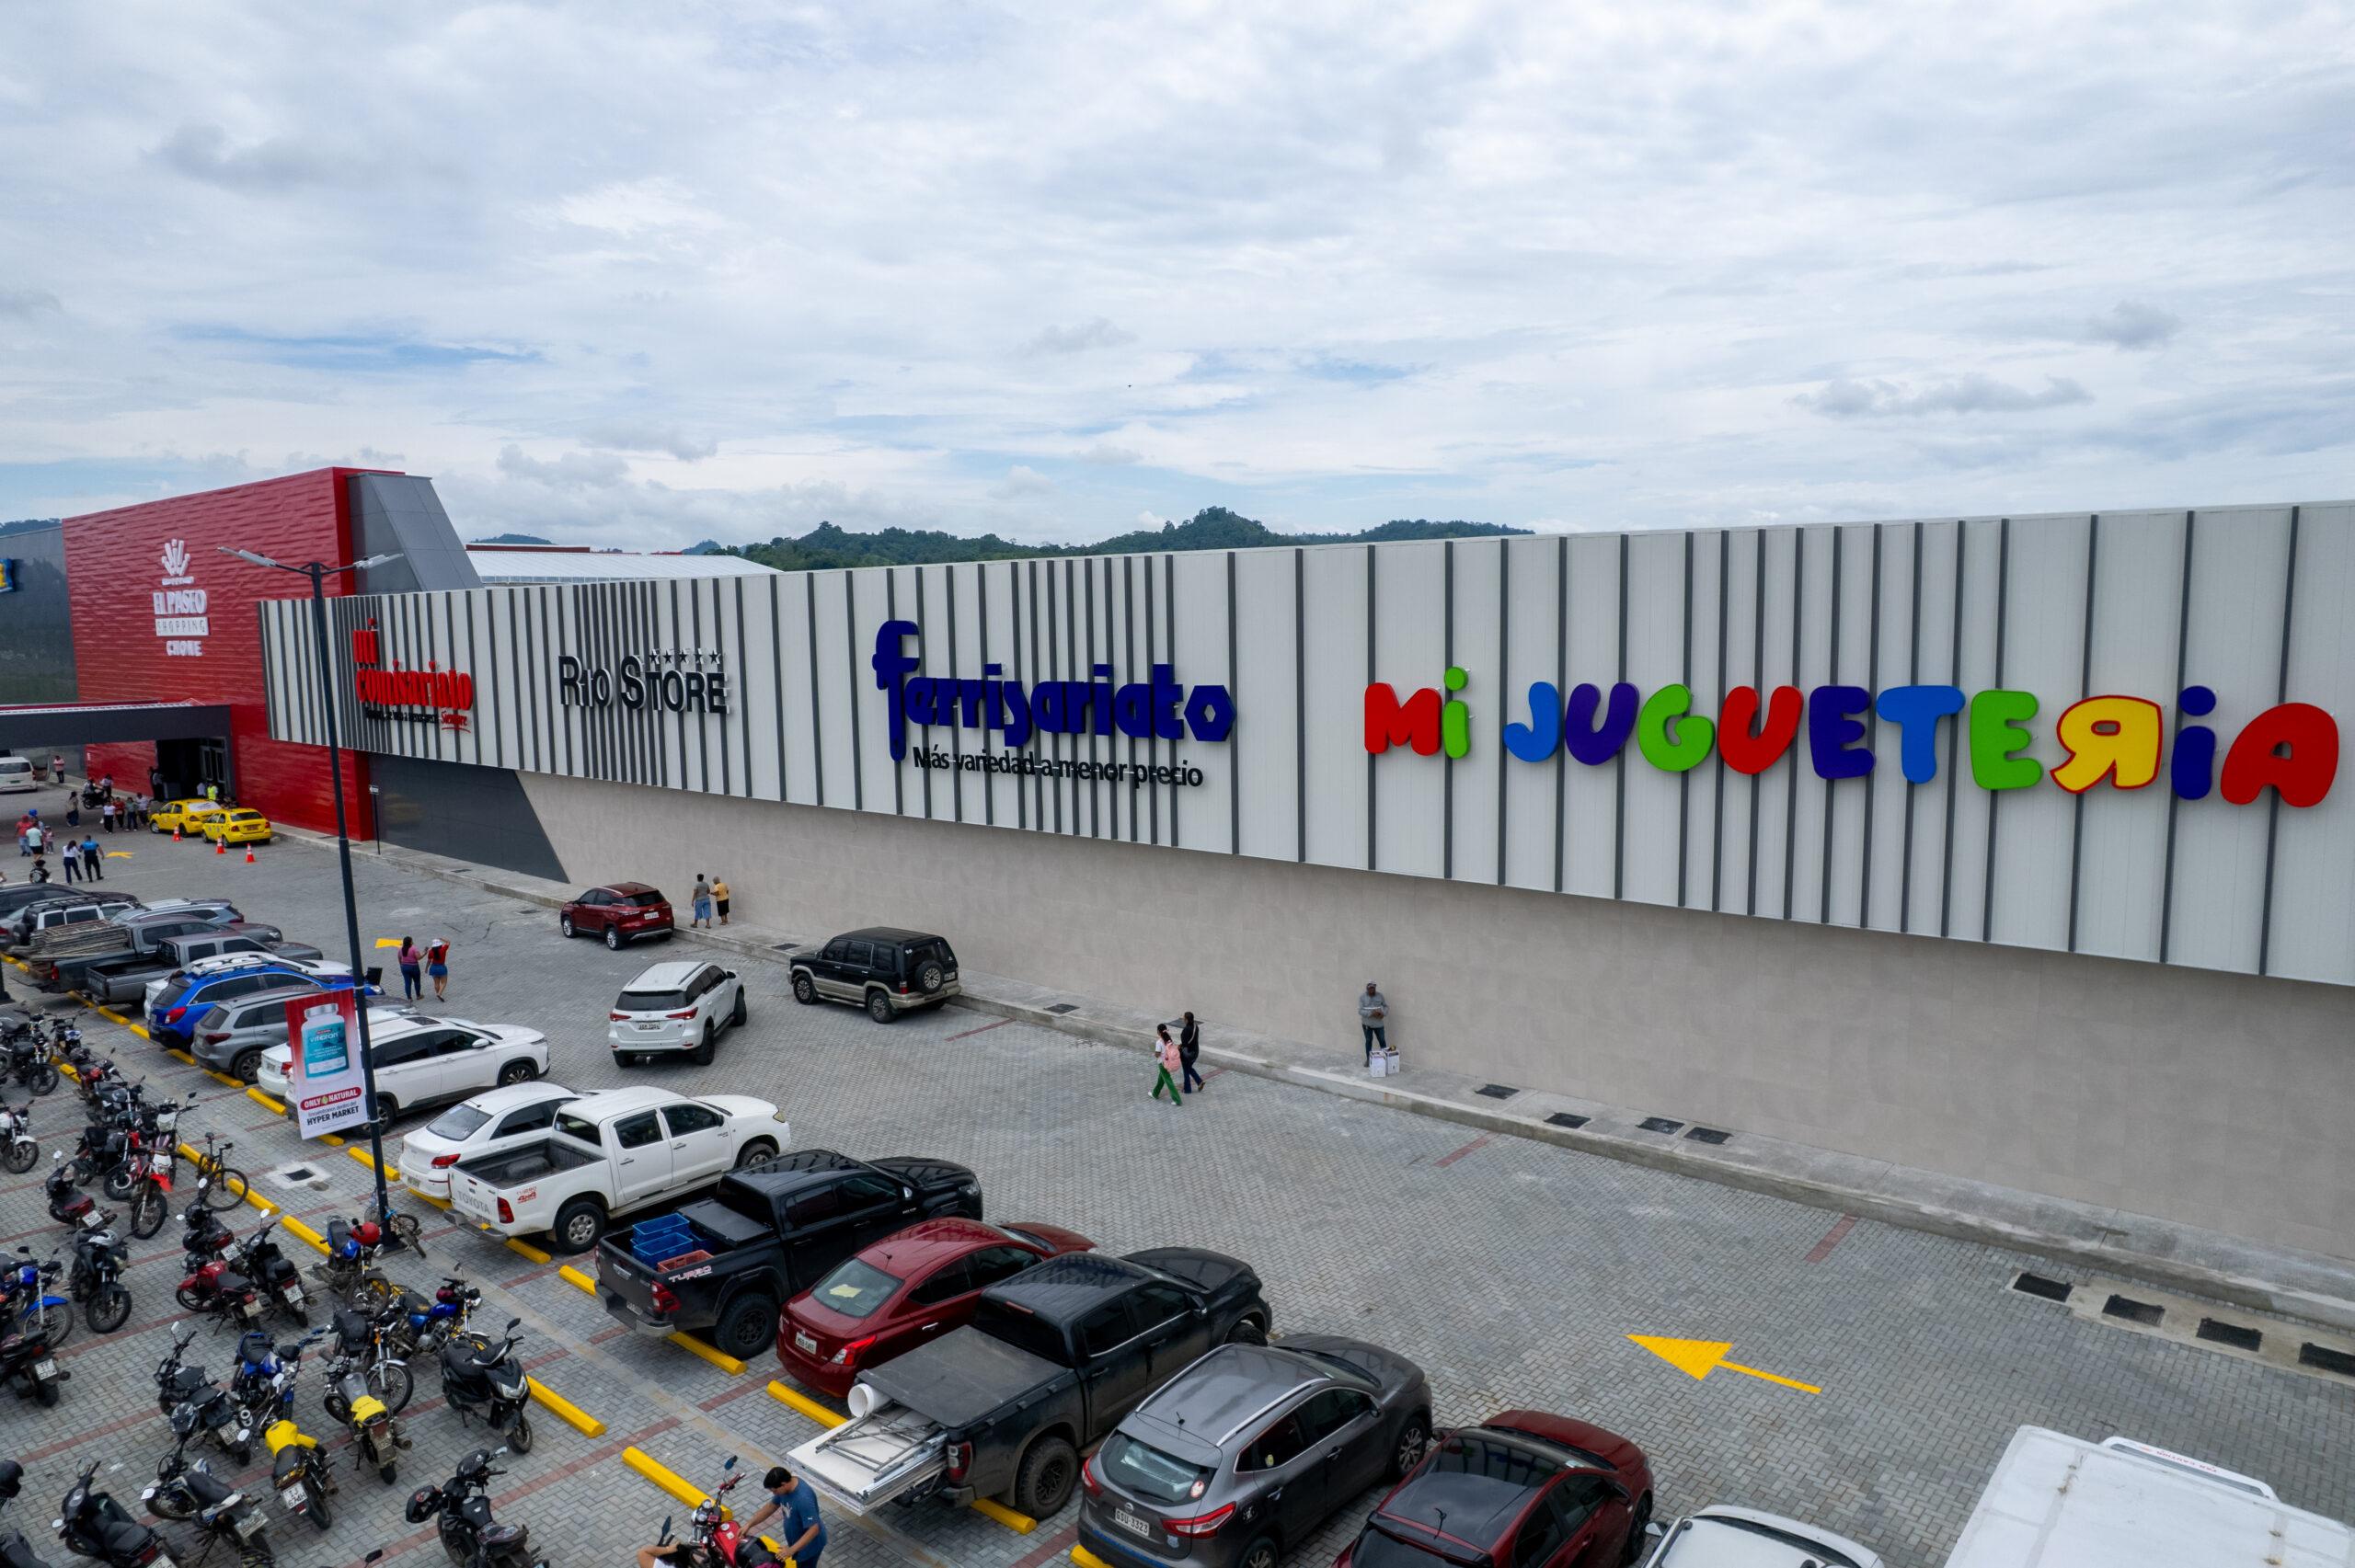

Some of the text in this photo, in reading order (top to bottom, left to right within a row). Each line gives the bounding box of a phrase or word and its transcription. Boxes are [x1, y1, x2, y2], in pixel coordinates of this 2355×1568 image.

[167, 589, 207, 614] PASEO
[156, 619, 206, 634] SHOPPING
[355, 658, 474, 712] comisariato
[872, 620, 1236, 762] ferrisariato
[913, 744, 1203, 788] Más variedad a menor precio
[304, 1089, 358, 1108] ONLY NATURAL
[306, 1114, 331, 1126] HYPER
[331, 1105, 360, 1119] MARKET
[457, 1190, 491, 1215] TOYOTA
[668, 1265, 713, 1283] TURBO
